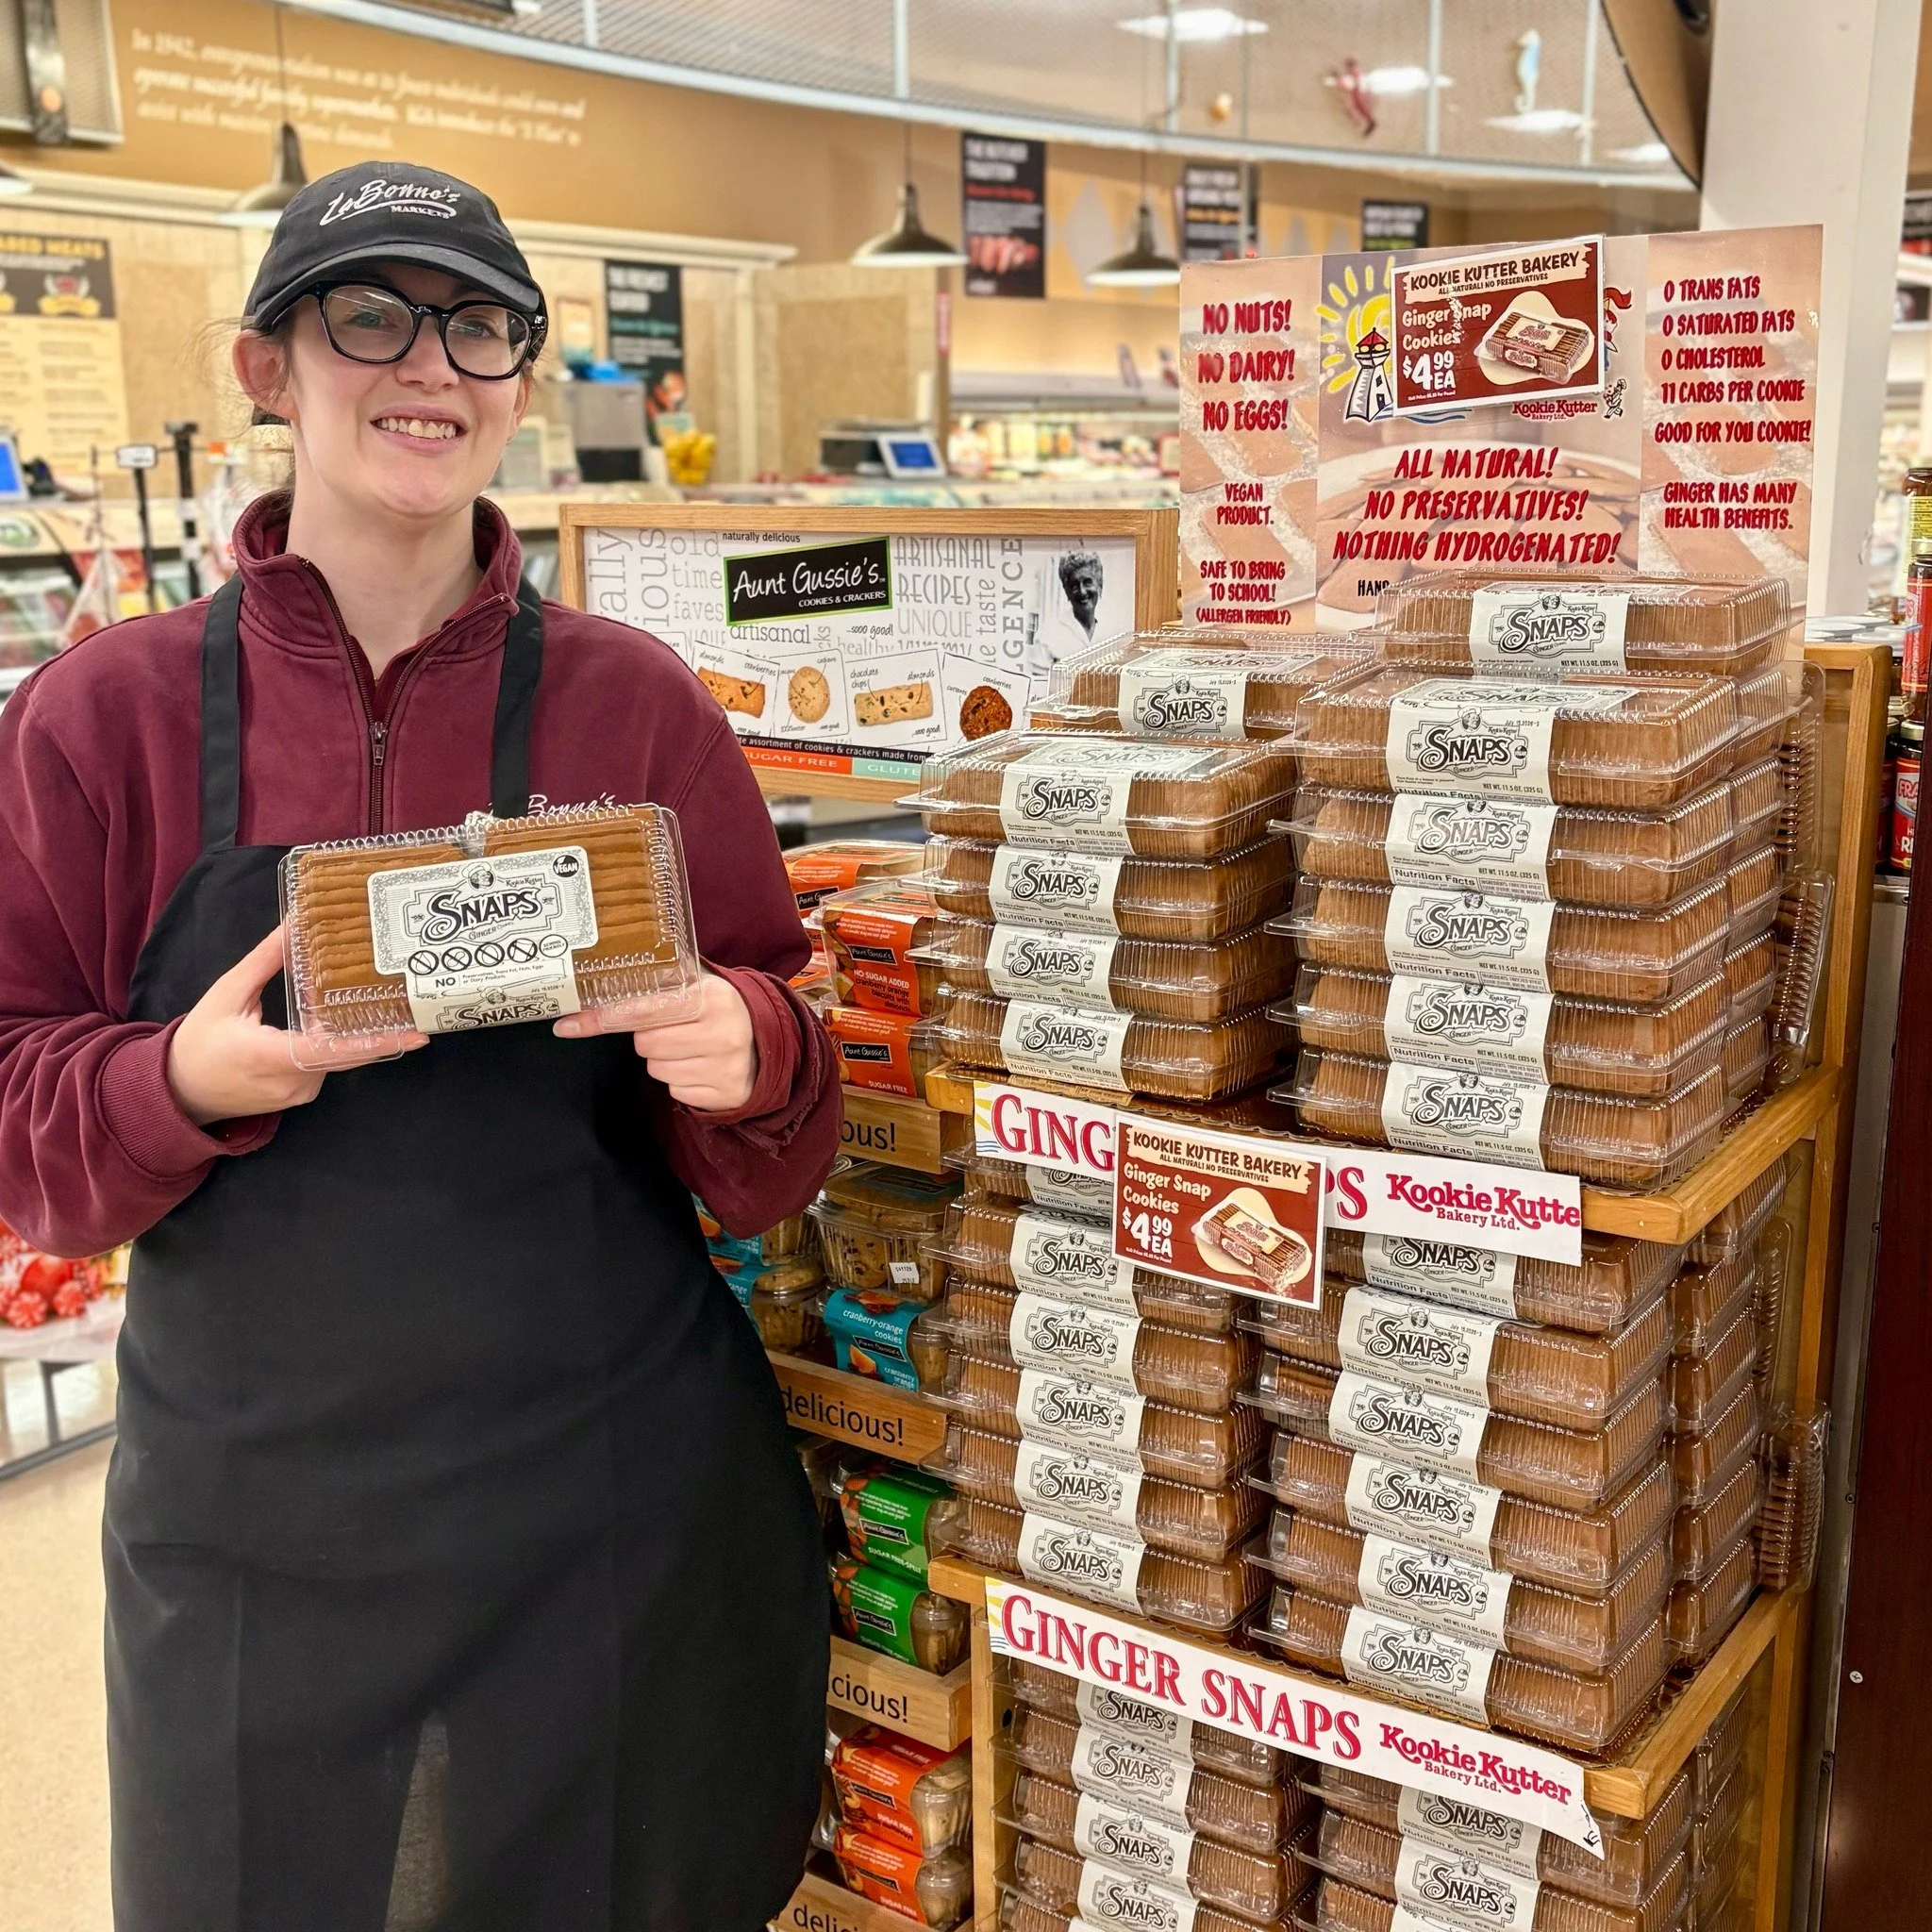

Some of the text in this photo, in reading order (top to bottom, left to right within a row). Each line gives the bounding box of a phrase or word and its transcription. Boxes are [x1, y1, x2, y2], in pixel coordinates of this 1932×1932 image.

[391, 205, 450, 219] MARKETS
[1410, 251, 1579, 291] KOOKIE KUTTER BAKERY
[1485, 280, 1495, 291] NO
[1496, 273, 1549, 287] PRESERVATIVES
[1679, 278, 1723, 301] TRANS
[1727, 275, 1760, 299] FATS
[1203, 299, 1291, 335] NO NUTS!
[1402, 308, 1451, 328] Ginger
[1677, 311, 1757, 336] SATURATED
[1761, 309, 1795, 332] FATS
[1403, 330, 1461, 351] Cookies
[1197, 349, 1295, 384] NO DAIRY!
[1675, 345, 1765, 370] CHOLESTEROL
[1434, 371, 1456, 390] EA
[1661, 379, 1806, 404] 11 CARBS PER COOKIE
[1203, 398, 1289, 431] NO EGGS!
[1512, 400, 1597, 416] Kookie Kutter
[1655, 420, 1811, 443] GOOD FOR YOU COOKIE!
[1393, 447, 1559, 480] ALL NATURAL!
[1224, 482, 1263, 503] VEGAN
[1364, 489, 1590, 521] NO PRESERVATIVES!
[1663, 482, 1797, 506] GINGER HAS MANY
[1217, 506, 1274, 525] PRODUCT.
[1665, 508, 1793, 530] HEALTH BENEFITS.
[723, 531, 800, 543] naturally delicious
[1333, 530, 1622, 564] NOTHING HYDROGENATED!
[894, 537, 995, 569] ARTISANAL
[672, 563, 723, 589] time
[733, 556, 878, 603] Aunt Gussie's
[1200, 560, 1285, 581] SAFE TO BRING
[799, 596, 834, 608] COOKIES
[842, 590, 886, 603] CRACKERS
[896, 574, 971, 605] RECIPES
[1209, 583, 1276, 603] TO SCHOOL!
[673, 593, 724, 623] faves
[1195, 607, 1291, 626] (ALLERGEN FRIENDLY)
[730, 623, 811, 644] artisanal
[897, 608, 973, 639] UNIQUE
[1500, 608, 1590, 653] SNAPS
[850, 668, 879, 678] chocolate
[749, 738, 791, 749] assortment
[794, 741, 803, 750] of
[805, 742, 834, 754] cookies
[846, 747, 879, 758] crackers
[882, 750, 904, 759] made
[908, 752, 926, 762] from
[799, 757, 838, 768] FREE
[553, 861, 578, 874] VEGAN
[1394, 869, 1475, 887] Nutrition Facts
[1014, 861, 1089, 900] SNAPS
[422, 889, 543, 944] SNAPS
[469, 927, 497, 941] GINGER
[435, 977, 456, 988] NO
[854, 969, 909, 989] NO SUGAR ADDED
[1415, 990, 1513, 1035] SNAPS
[1393, 1047, 1475, 1066] Nutrition Facts
[869, 1080, 908, 1094] SUGAR FREE
[1133, 1131, 1302, 1180] KOOKIE KUTTER BAKERY
[1159, 1153, 1172, 1163] ALL
[1206, 1162, 1216, 1172] NO
[1217, 1165, 1270, 1183] PRESERVATIVES
[1123, 1162, 1212, 1202] Ginger Snap
[1386, 1174, 1492, 1213] Kookie
[1123, 1186, 1179, 1215] Cookies
[1437, 1208, 1521, 1231] Bakery Ltd.
[1152, 1236, 1173, 1259] EA
[1372, 1275, 1448, 1300] Nutrition Facts
[842, 1309, 904, 1336] cranberry-orange
[874, 1330, 903, 1345] cookies
[1032, 1315, 1108, 1357] SNAPS
[1374, 1472, 1463, 1524] SNAPS
[1386, 1557, 1477, 1607] SNAPS
[1001, 1593, 1361, 1761] GINGER SNAPS
[1094, 1743, 1164, 1789] SNAPS
[1379, 1724, 1572, 1805] Kookie Kutter
[1424, 1760, 1502, 1793] Bakery Ltd.
[1421, 1863, 1505, 1915] SNAPS
